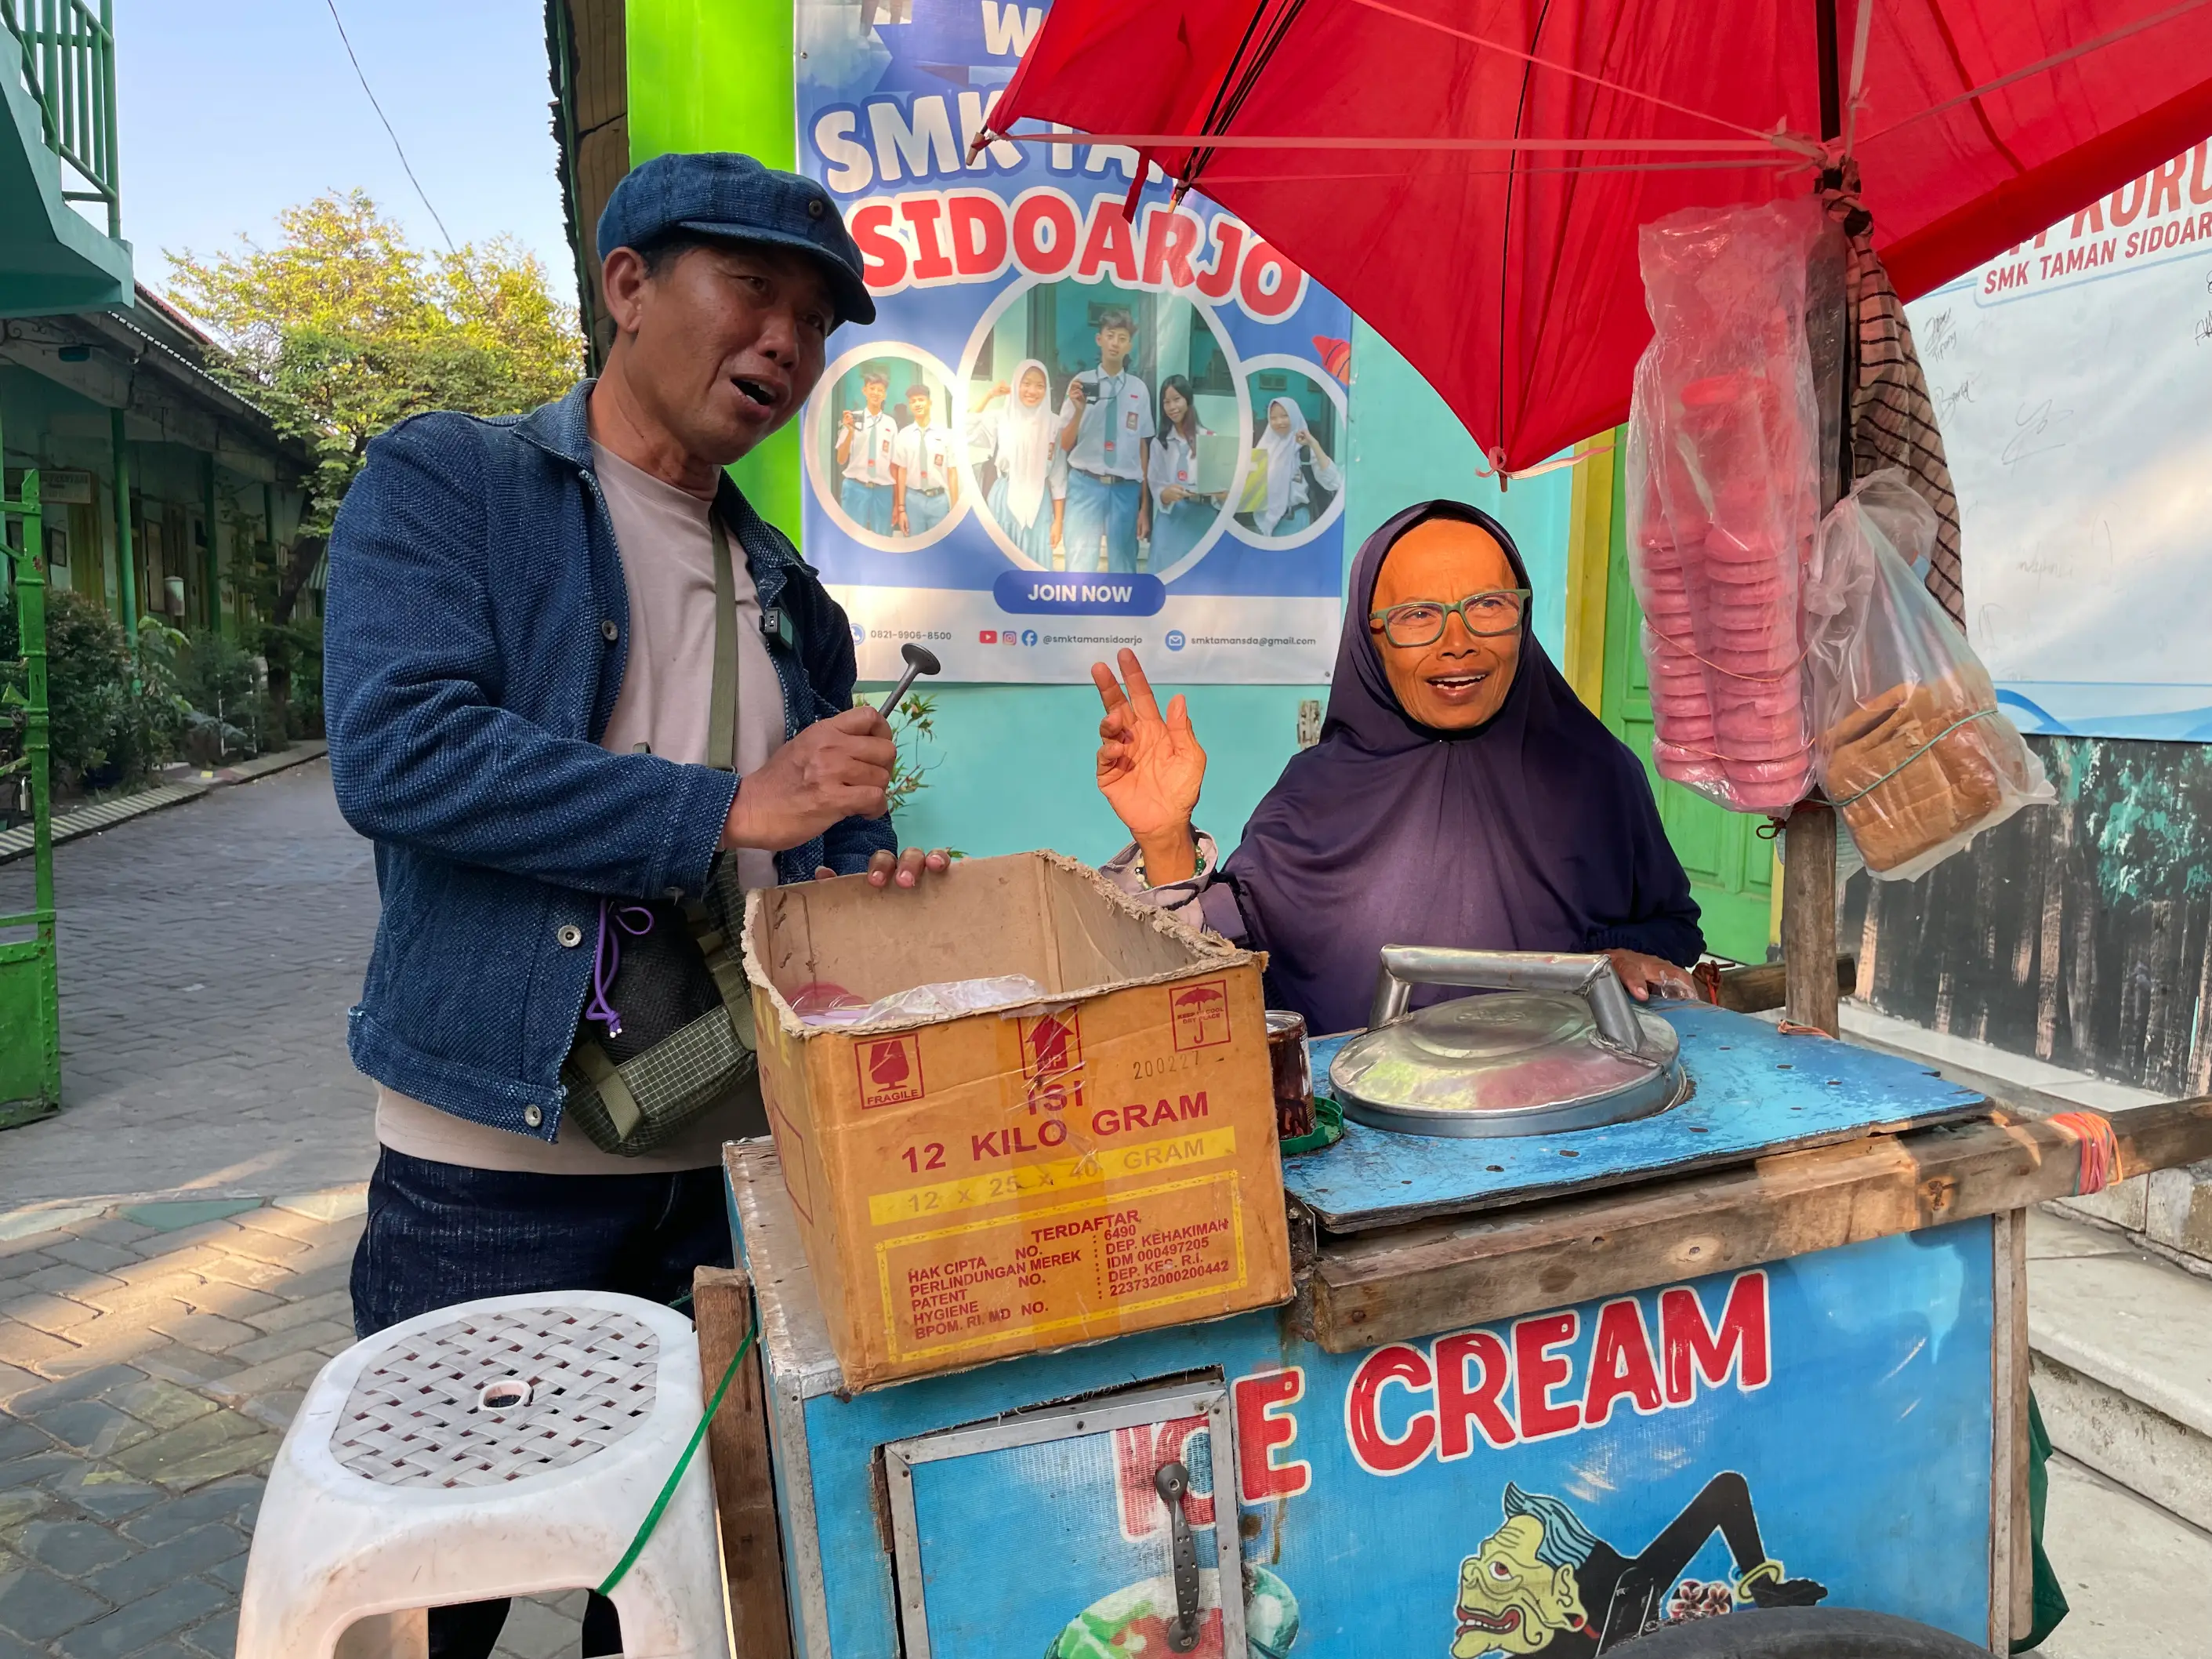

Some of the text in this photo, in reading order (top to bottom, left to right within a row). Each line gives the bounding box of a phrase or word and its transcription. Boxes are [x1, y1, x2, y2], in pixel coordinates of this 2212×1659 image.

[815, 90, 1023, 194] SMK
[850, 194, 1304, 317] SIDOARJO
[1985, 260, 2030, 295] SMK
[2040, 238, 2117, 281] TAMAN
[1028, 584, 1133, 603] JOIN NOW
[870, 630, 952, 640] 0821-9906-8500
[1043, 634, 1143, 646] @smktamansidoarjo
[1191, 636, 1316, 647] smktamansda@gmail.com
[1133, 1051, 1199, 1080] 200227
[867, 1089, 919, 1105] FRAGILE
[1028, 1080, 1083, 1116] ISI
[901, 1091, 1209, 1173] 12 KILO GRAM
[908, 1191, 941, 1213] 12
[989, 1174, 1019, 1198] 25
[1069, 1158, 1099, 1181] 40
[1123, 1138, 1205, 1170] GRAM
[908, 1265, 941, 1283] HAK
[944, 1256, 987, 1276] CIPTA
[1015, 1245, 1043, 1261] NO.
[1104, 1225, 1137, 1241] 6490
[1032, 1210, 1140, 1243] TERDAFTAR
[909, 1261, 1026, 1298] PERLINDUNGAN
[1030, 1250, 1082, 1271] MEREK
[1105, 1240, 1137, 1255] DEP.
[1141, 1218, 1229, 1248] KEHAKIMAN
[912, 1289, 969, 1312] PATENT
[1018, 1272, 1046, 1288] NO.
[1107, 1253, 1134, 1269] IDM
[1137, 1236, 1209, 1262] 000497205
[913, 1301, 979, 1326] HYGIENE
[1108, 1266, 1140, 1283] DEP.
[1181, 1252, 1203, 1267] R.I.
[915, 1320, 963, 1340] BPOM.
[966, 1315, 985, 1330] RI.
[988, 1308, 1011, 1323] MD
[1021, 1301, 1049, 1316] NO.
[1110, 1260, 1229, 1297] 223732000200442
[1346, 1269, 1770, 1477] CREAM
